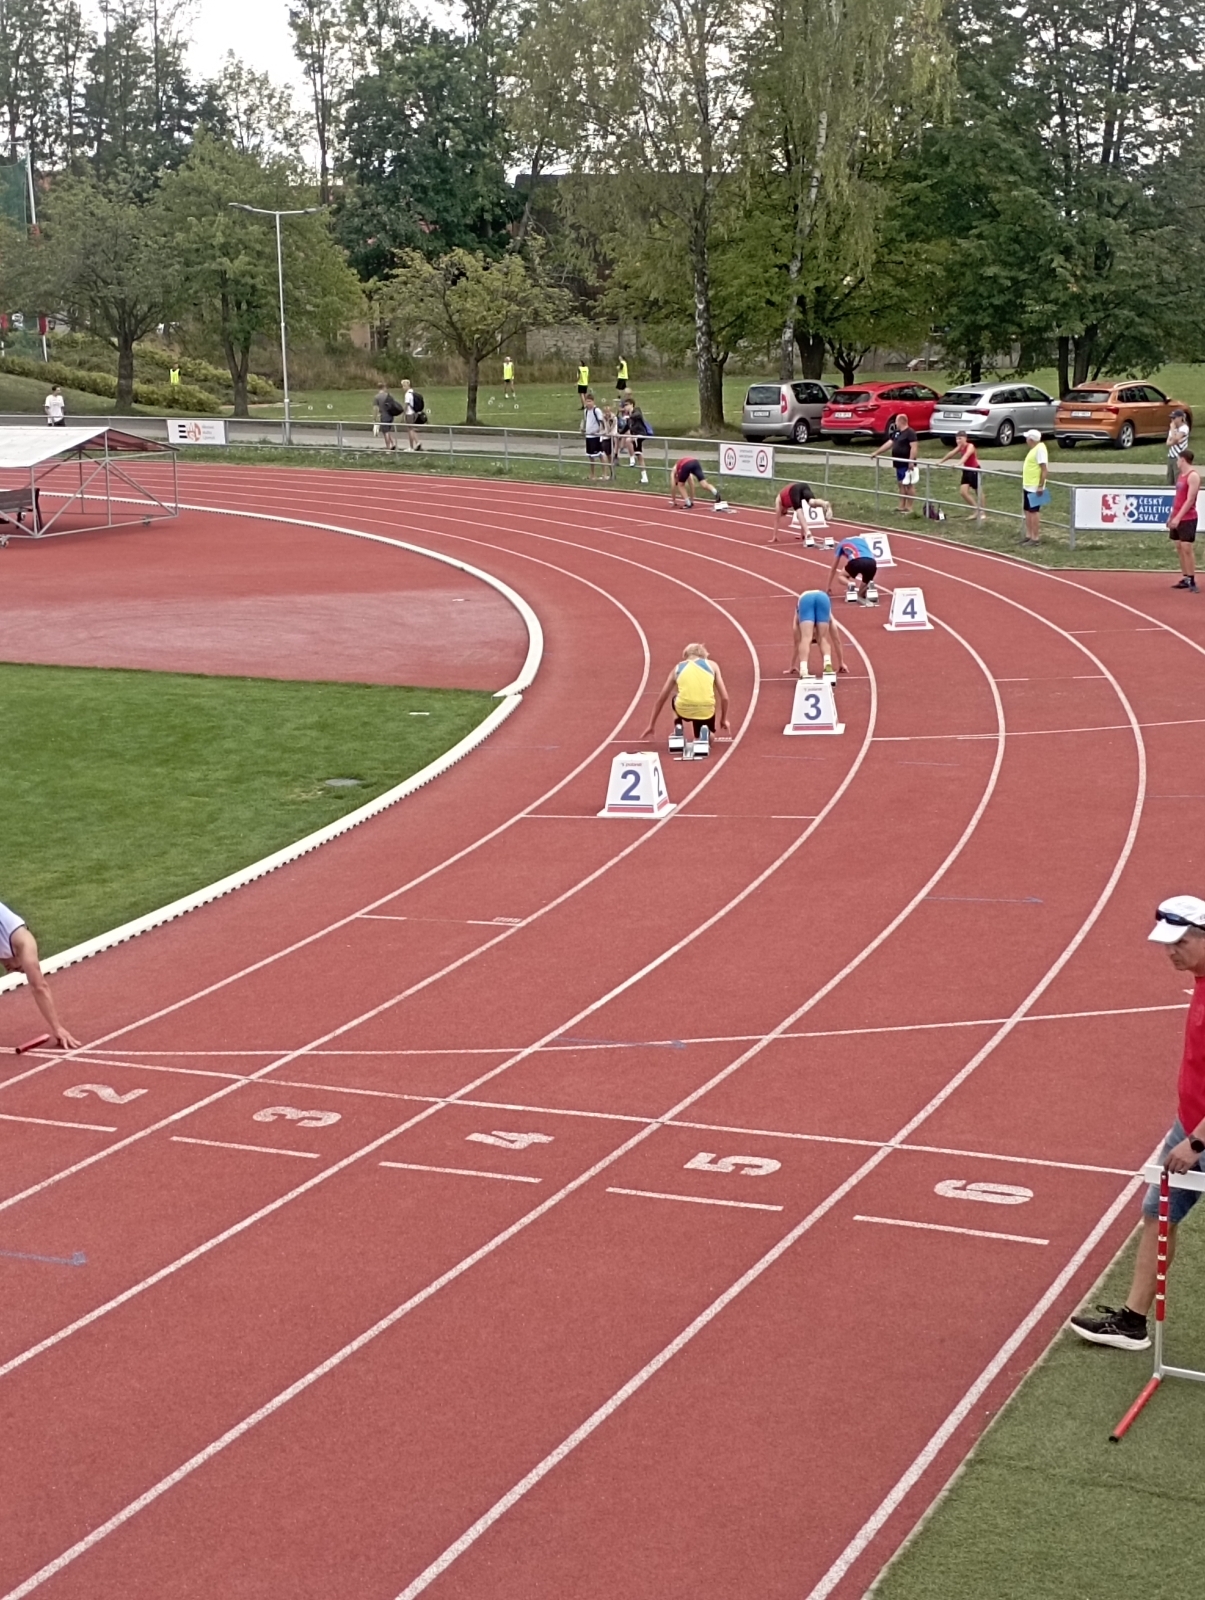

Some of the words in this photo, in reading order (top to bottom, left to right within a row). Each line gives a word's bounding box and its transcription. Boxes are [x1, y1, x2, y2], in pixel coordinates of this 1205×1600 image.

[1138, 505, 1173, 514] ATLETIC
[1139, 496, 1163, 505] ČESKÝ
[808, 507, 818, 520] 6
[1139, 513, 1159, 521] SVAZ
[872, 540, 883, 558] 5
[902, 598, 917, 619] 4
[804, 694, 821, 720] 3
[620, 769, 641, 801] 2
[653, 766, 663, 797] 2
[63, 1084, 149, 1104] 2
[252, 1106, 342, 1127] 3
[465, 1130, 555, 1150] 4
[683, 1152, 781, 1176] 5
[933, 1180, 1034, 1205] 6
